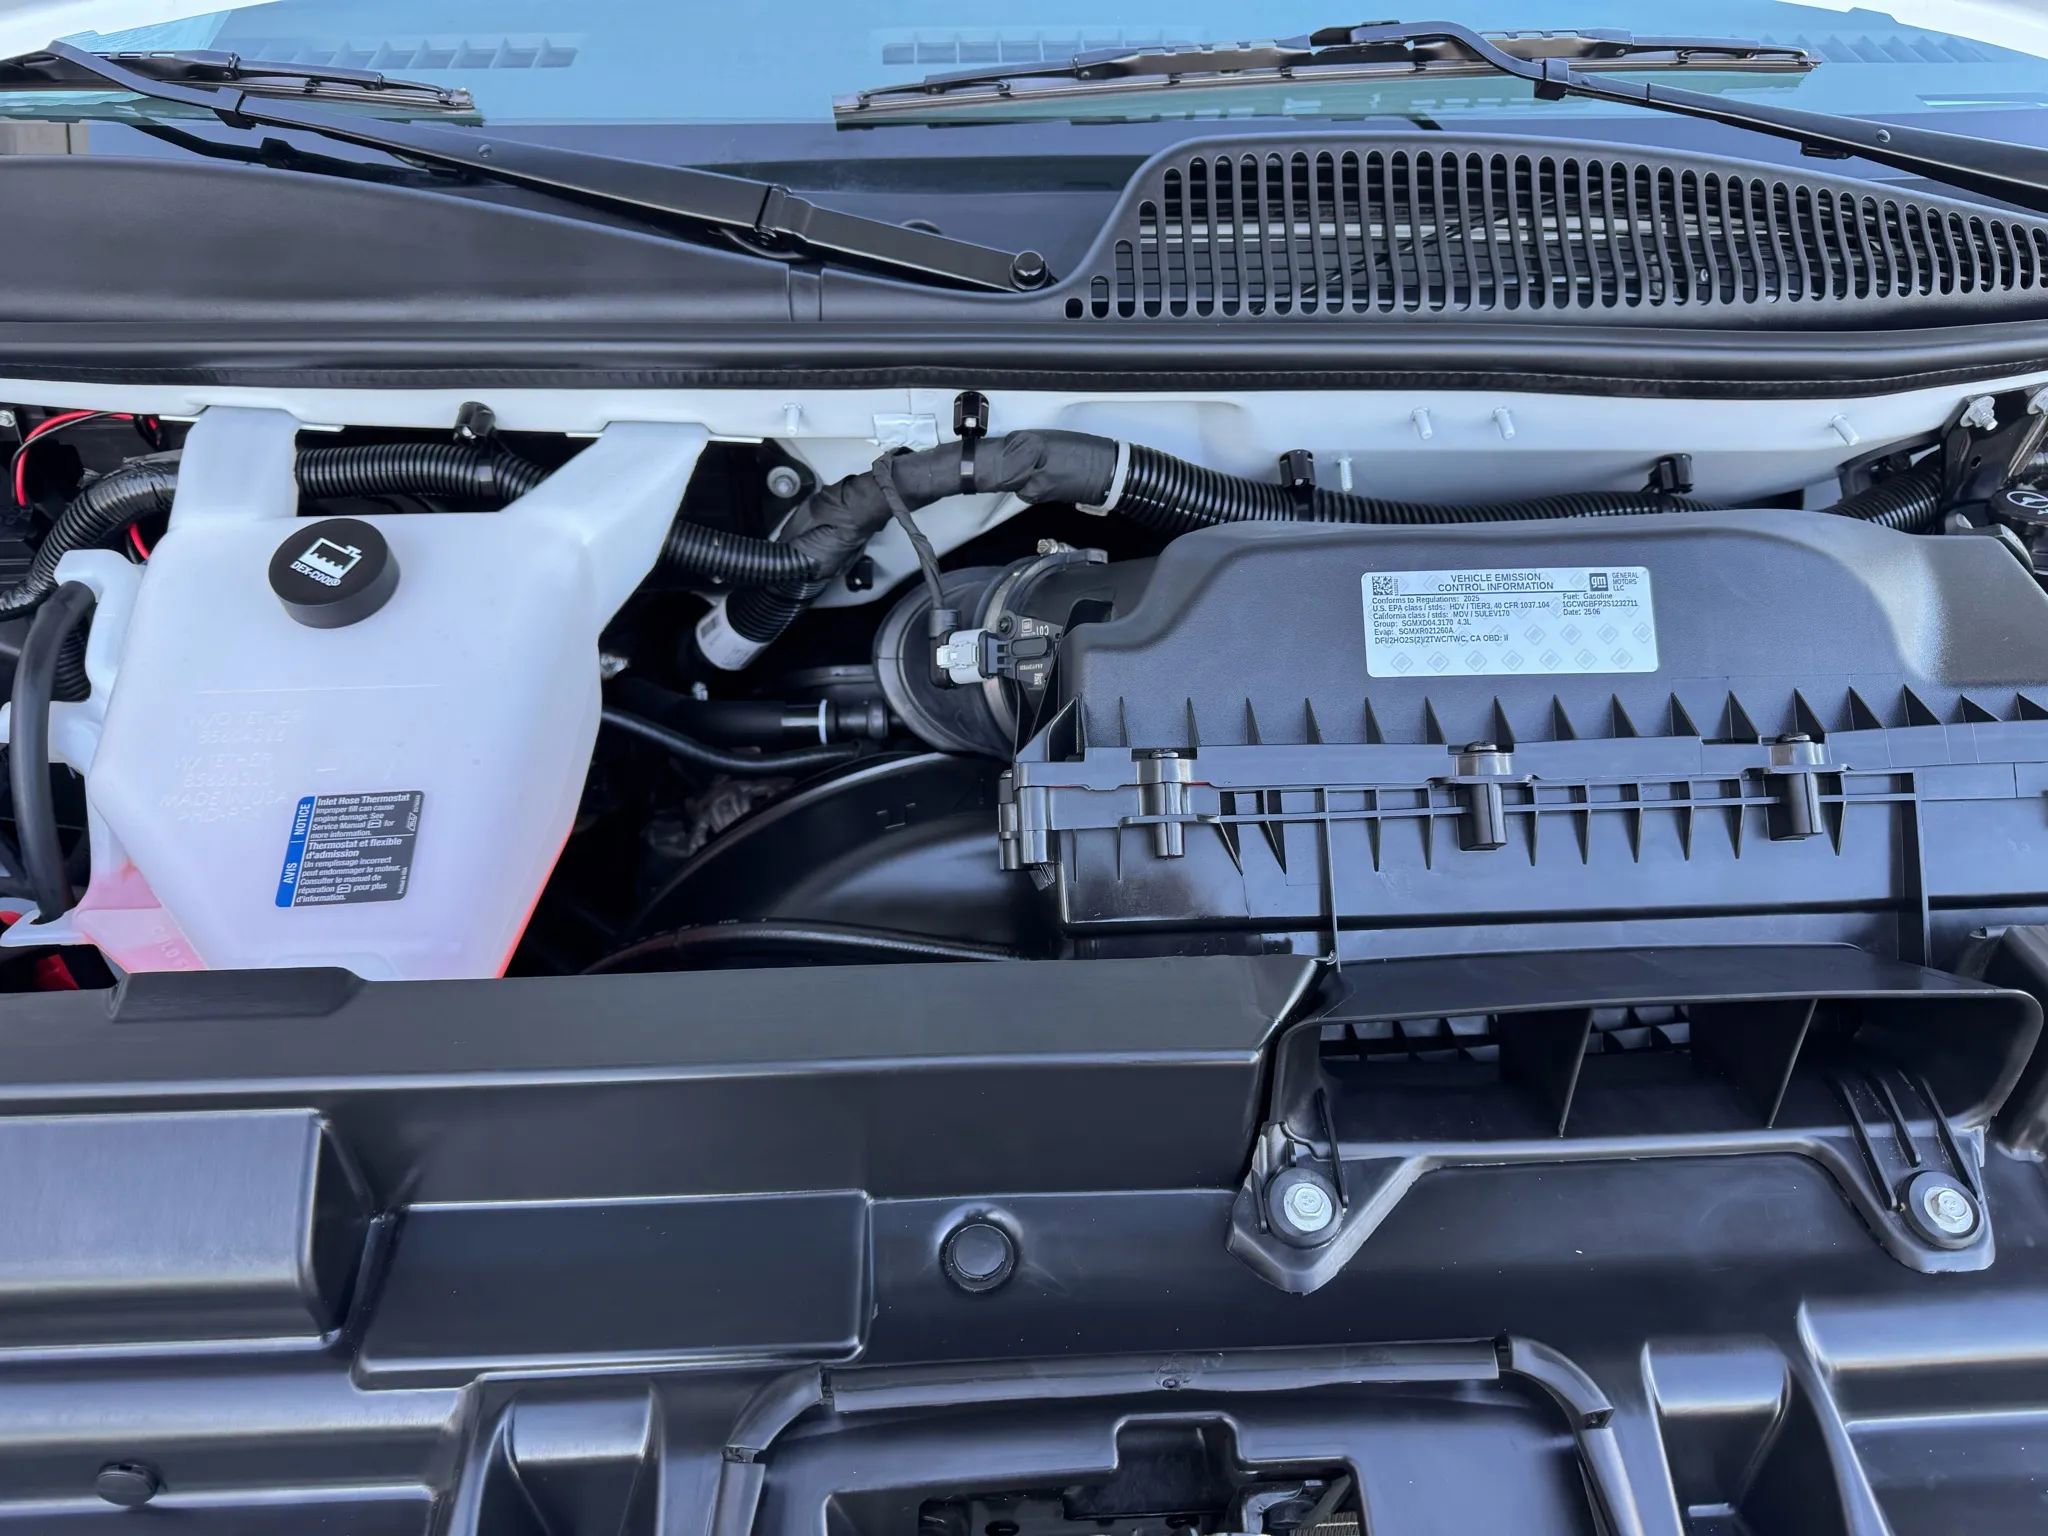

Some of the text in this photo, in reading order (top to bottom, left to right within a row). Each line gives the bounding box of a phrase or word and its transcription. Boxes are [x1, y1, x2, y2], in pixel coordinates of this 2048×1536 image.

[1450, 573, 1541, 583] VEHICLE EMISSION
[1591, 576, 1607, 588] gm
[1438, 582, 1553, 591] CONTROL INFORMATION
[318, 798, 337, 806] Inlet
[362, 794, 409, 803] Thermostat
[316, 806, 347, 814] Improper
[294, 804, 310, 835] NOTICE
[308, 841, 357, 850] Thermostat
[370, 838, 402, 846] flexible
[306, 850, 359, 859] d'admission
[315, 860, 358, 868] remplissage
[283, 863, 298, 883] AVIS
[319, 868, 365, 876] endommager
[300, 877, 334, 885] Consulter
[298, 885, 334, 894] réparation
[353, 884, 370, 892] pour
[296, 894, 346, 903] d'information.
